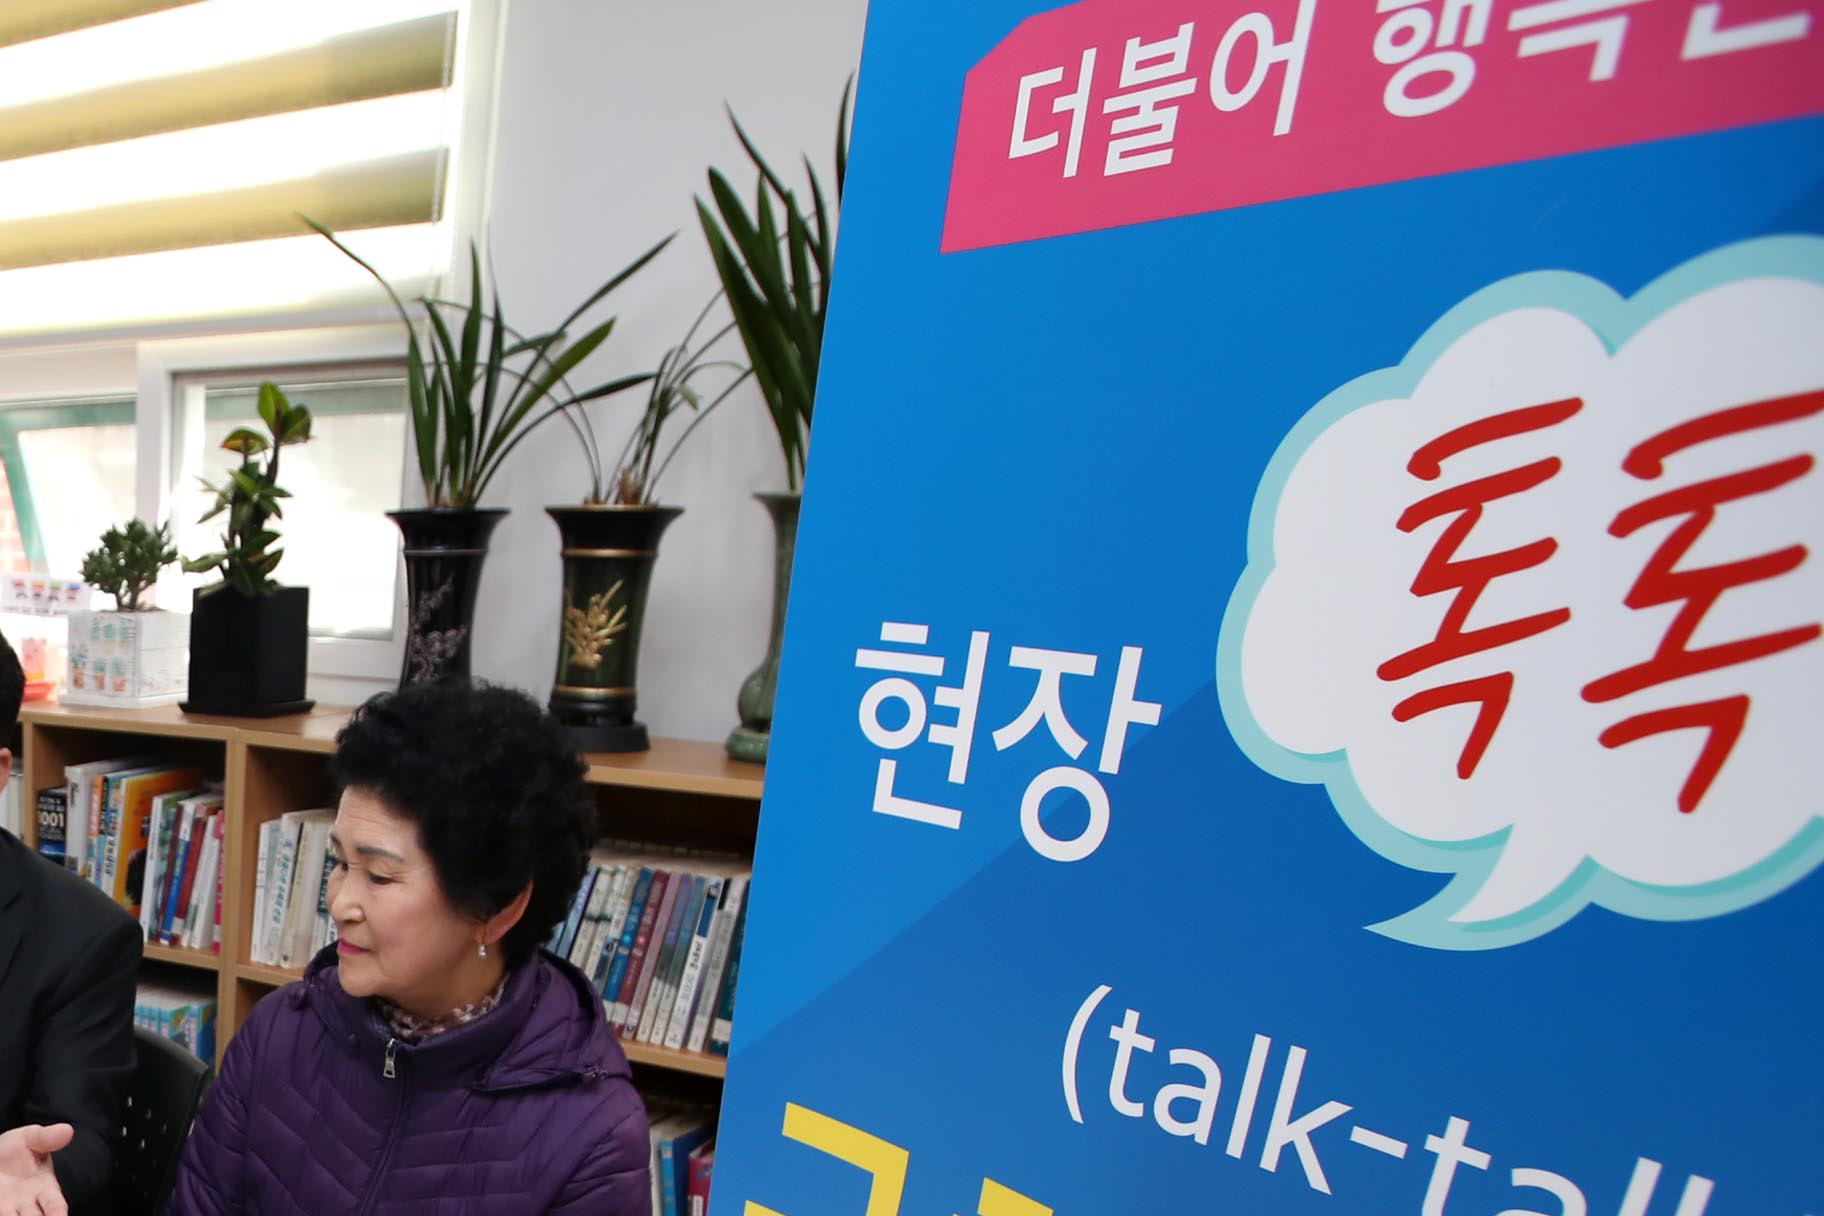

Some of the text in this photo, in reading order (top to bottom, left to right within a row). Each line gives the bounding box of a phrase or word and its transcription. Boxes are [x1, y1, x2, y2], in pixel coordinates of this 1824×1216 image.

[1007, 0, 1319, 178] 더불어
[855, 386, 1824, 862] 현장 톡톡
